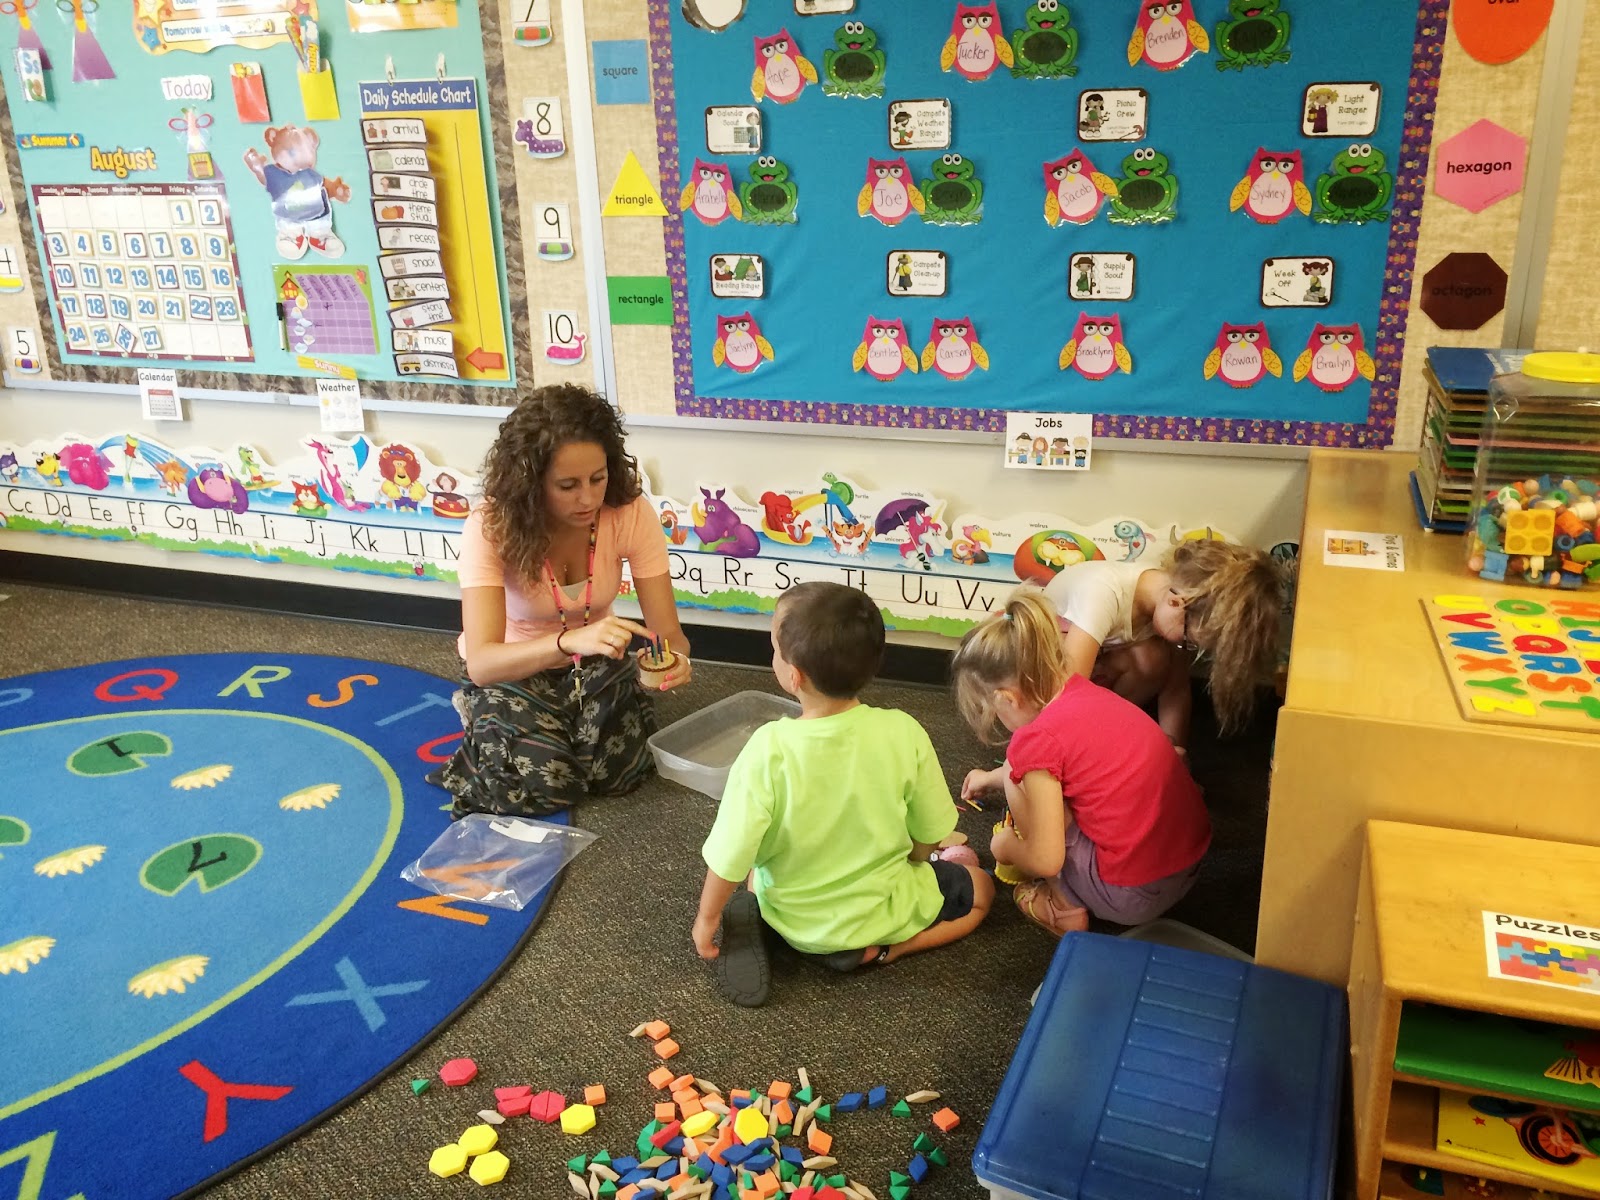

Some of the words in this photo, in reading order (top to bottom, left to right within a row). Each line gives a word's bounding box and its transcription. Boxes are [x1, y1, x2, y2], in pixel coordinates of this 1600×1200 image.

[164, 24, 205, 36] Tomorrow
[1147, 27, 1185, 48] Brenden
[958, 42, 989, 60] Tucker
[602, 65, 638, 79] square
[766, 67, 793, 85] Hope
[164, 79, 212, 98] Today
[363, 89, 390, 110] Daily
[391, 88, 439, 106] Schedule
[440, 85, 472, 104] Chart
[1344, 94, 1365, 104] Light
[1116, 110, 1135, 118] Crew
[1338, 105, 1367, 115] Ranger
[535, 102, 551, 135] 8
[917, 119, 945, 127] Weather
[392, 123, 420, 135] arrival
[919, 129, 943, 138] Ranger
[31, 135, 68, 147] Summer
[91, 146, 158, 179] August
[394, 154, 426, 166] calendar
[1446, 159, 1512, 175] hexagon
[615, 193, 653, 205] triangle
[874, 188, 902, 207] Joe
[1061, 184, 1092, 207] Jacob
[1250, 185, 1286, 204] Sydney
[175, 205, 185, 221] 1
[204, 205, 216, 221] 2
[543, 207, 562, 239] 9
[51, 236, 64, 252] 3
[77, 235, 87, 251] 4
[102, 235, 112, 251] 5
[130, 237, 142, 254] 6
[155, 237, 165, 253] 7
[180, 238, 194, 255] 8
[210, 238, 222, 256] 9
[409, 233, 436, 245] recess
[412, 256, 436, 268] snack
[1103, 262, 1126, 271] Supply
[56, 267, 73, 284] 10
[82, 267, 97, 284] 11
[105, 267, 123, 285] 12
[131, 270, 149, 287] 13
[157, 269, 176, 286] 14
[184, 270, 202, 286] 15
[211, 268, 230, 286] 16
[1104, 271, 1124, 279] Scout
[1273, 269, 1296, 278] Week
[415, 282, 446, 293] centers
[1431, 283, 1493, 299] octagon
[62, 297, 76, 313] 17
[86, 298, 105, 315] 18
[112, 299, 129, 316] 19
[138, 299, 156, 315] 20
[166, 300, 181, 316] 21
[191, 300, 211, 316] 22
[216, 300, 236, 316] 23
[618, 293, 664, 306] rectangle
[548, 313, 574, 344] 10
[16, 329, 30, 355] 5
[68, 326, 86, 342] 24
[93, 329, 110, 344] 25
[117, 327, 133, 350] 26
[142, 329, 158, 345] 27
[424, 335, 447, 346] music
[939, 347, 970, 359] Carson
[1075, 345, 1112, 358] Brooklynn
[313, 359, 341, 374] Sunny
[1225, 353, 1258, 366] Rowan
[1316, 357, 1351, 371] Brailyn
[139, 372, 174, 382] Calendar
[319, 382, 356, 393] Weather
[1035, 417, 1063, 428] Jobs
[7, 488, 33, 514] Cc
[44, 491, 73, 518] Dd
[88, 496, 113, 522] Ee
[126, 500, 146, 525] Ff
[164, 504, 199, 541] Gg
[213, 509, 244, 536] Hh
[260, 514, 276, 540] Ii
[304, 519, 327, 557] Jj
[349, 525, 379, 553] Kk
[403, 530, 426, 557] Ll
[668, 552, 709, 594] Qq
[724, 557, 754, 587] Rr
[901, 573, 938, 607] Uu
[956, 579, 995, 612] Vv
[94, 668, 180, 703] Q
[217, 665, 292, 698] R
[307, 674, 379, 708] S
[1495, 914, 1600, 941] Puzzles
[285, 956, 430, 1033] X
[178, 1059, 294, 1143] Y
